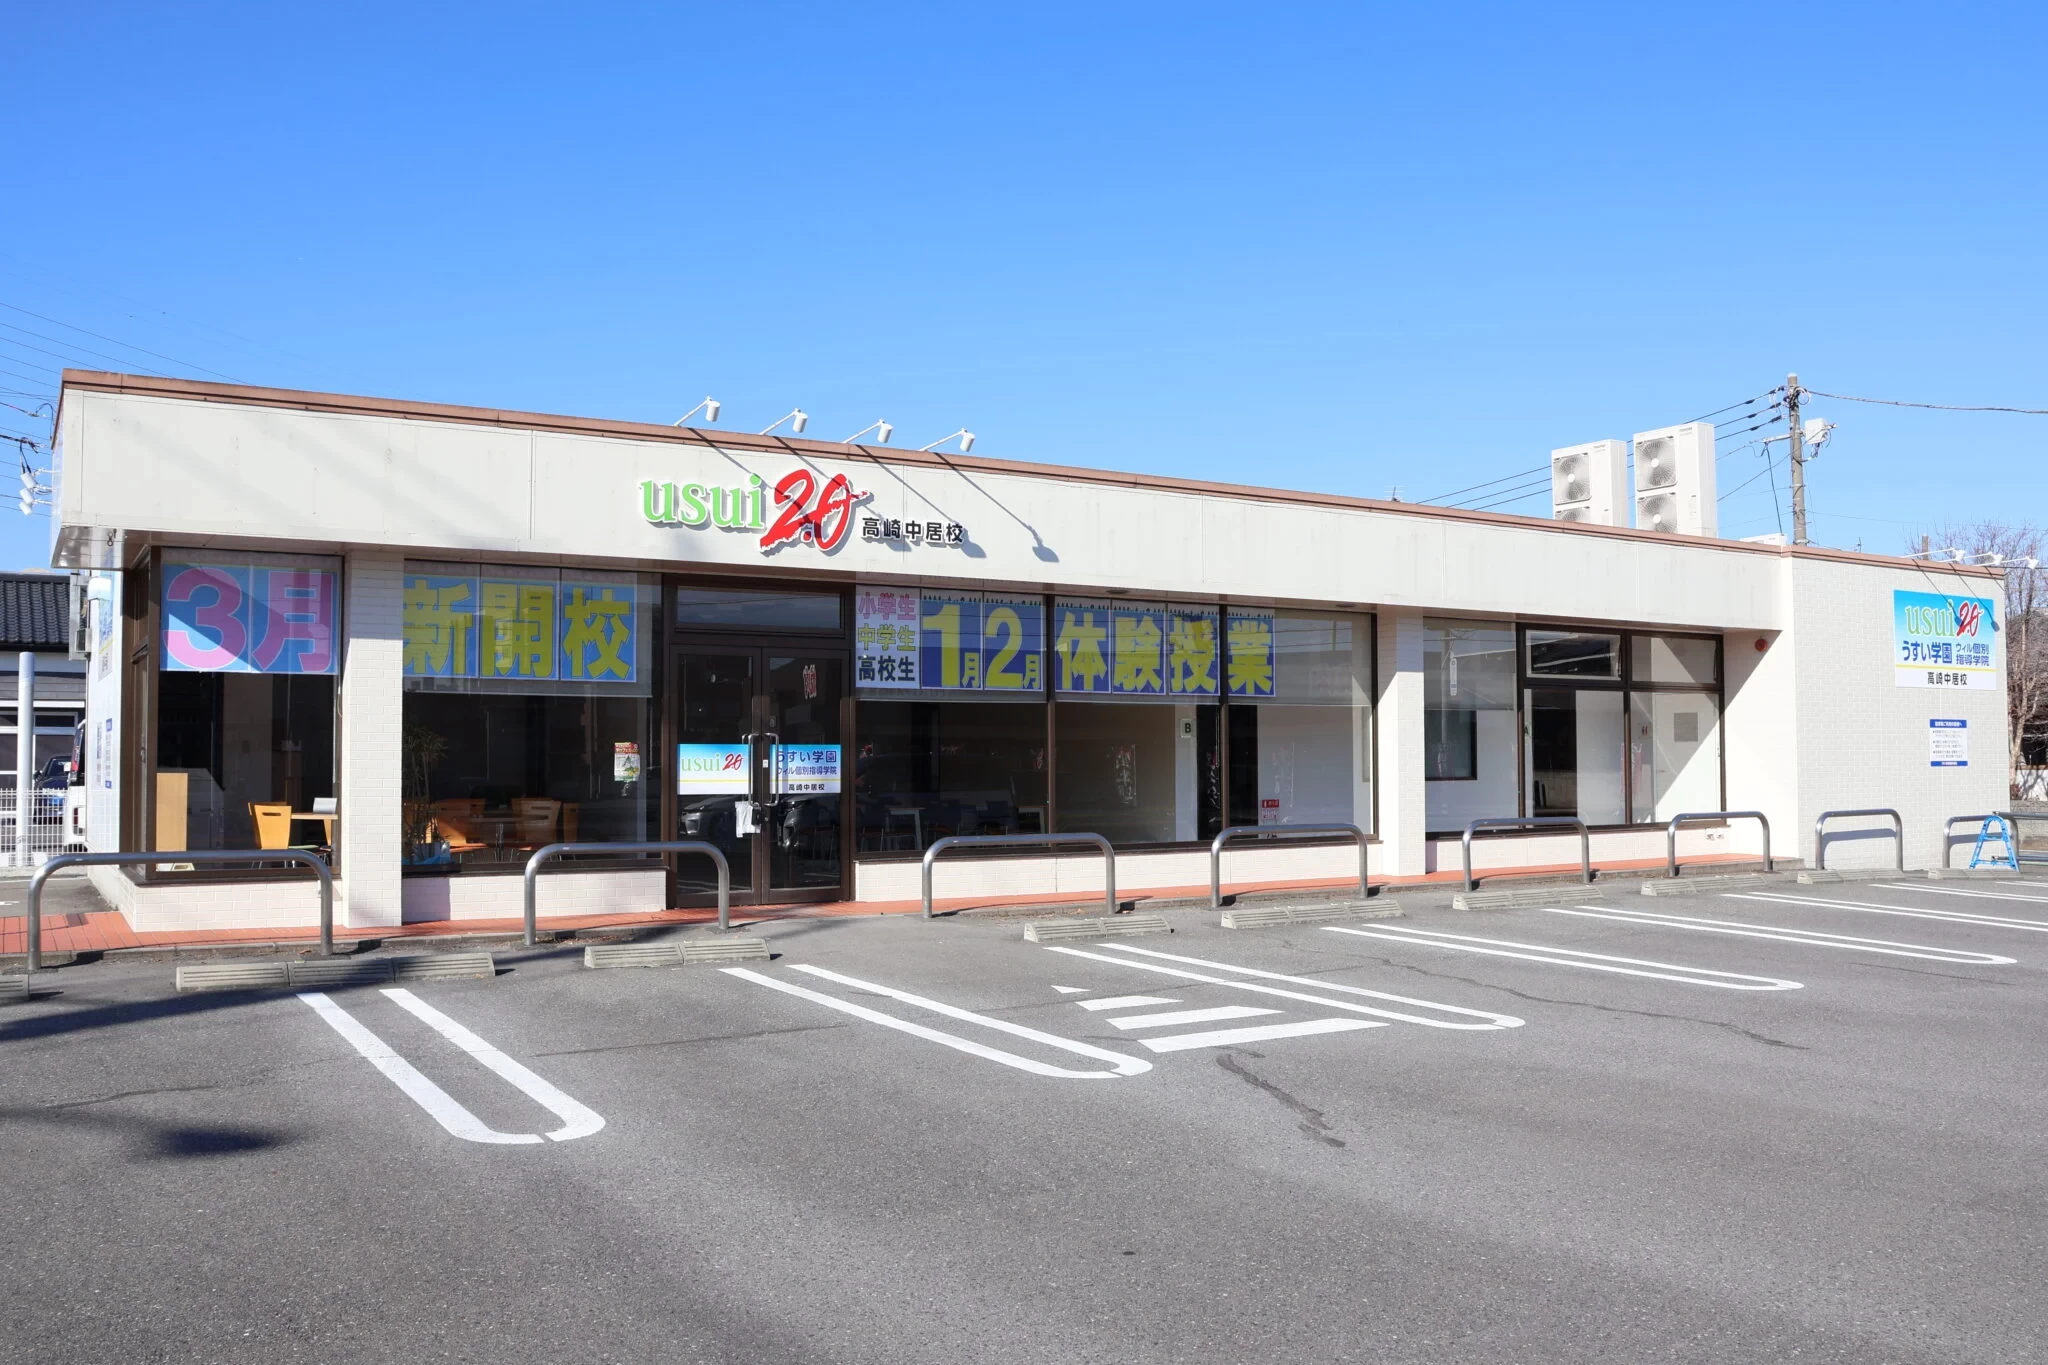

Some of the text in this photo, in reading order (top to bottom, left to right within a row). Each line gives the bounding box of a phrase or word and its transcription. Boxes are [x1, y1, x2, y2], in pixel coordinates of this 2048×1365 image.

[641, 472, 764, 528] usui
[862, 517, 964, 543] 高崎中居校
[858, 592, 916, 620] 小学生
[1905, 599, 1954, 636] usui
[163, 568, 335, 673] 3月
[404, 578, 630, 680] 新開校
[858, 623, 916, 651] 中学生
[1956, 643, 1989, 655] ウィル個別
[1902, 640, 1953, 664] うすい学園
[1956, 654, 1990, 667] 指導学院
[858, 655, 915, 681] 高校生
[1927, 672, 1968, 686] 高崎中居校
[681, 754, 720, 772] usui
